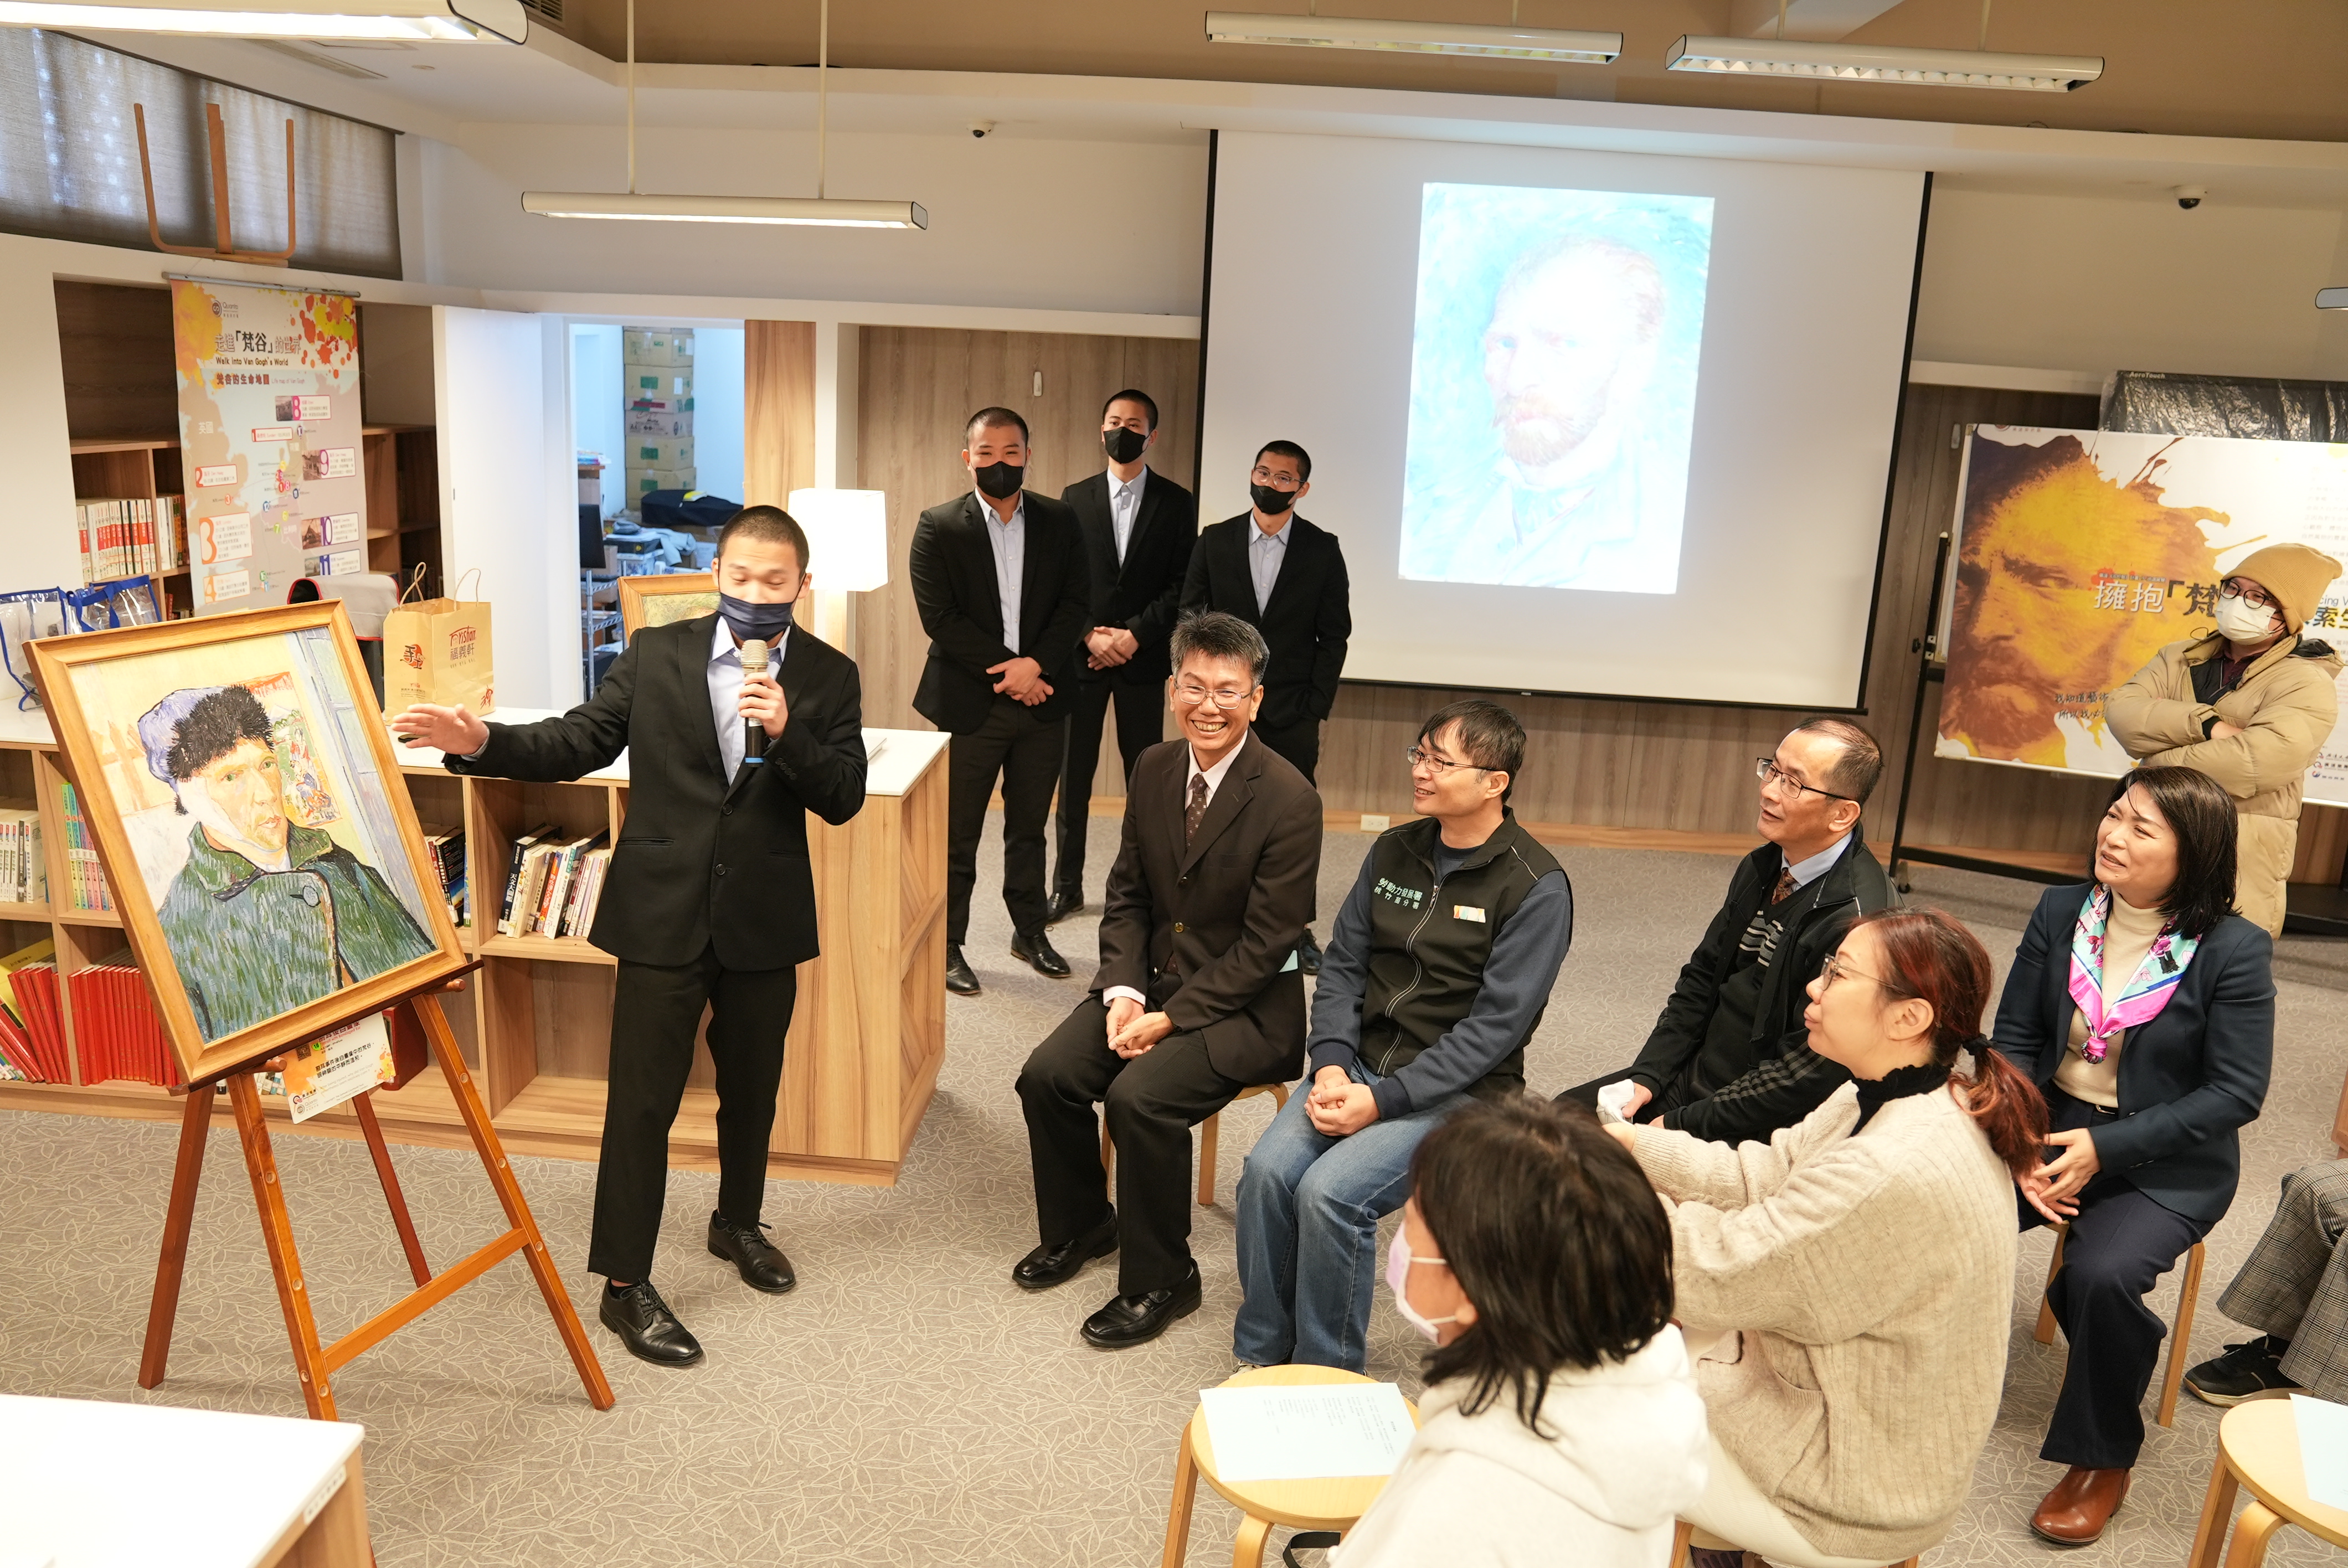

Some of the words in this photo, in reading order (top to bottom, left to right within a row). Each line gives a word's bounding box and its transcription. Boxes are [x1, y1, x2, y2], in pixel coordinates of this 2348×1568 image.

[214, 331, 301, 355] 走進「梵谷」的世界
[255, 357, 272, 367] Gogh's
[450, 643, 475, 661] 福義軒
[1374, 886, 1420, 910] 桃竹苗分署
[1378, 878, 1423, 901] 勞動力發展署
